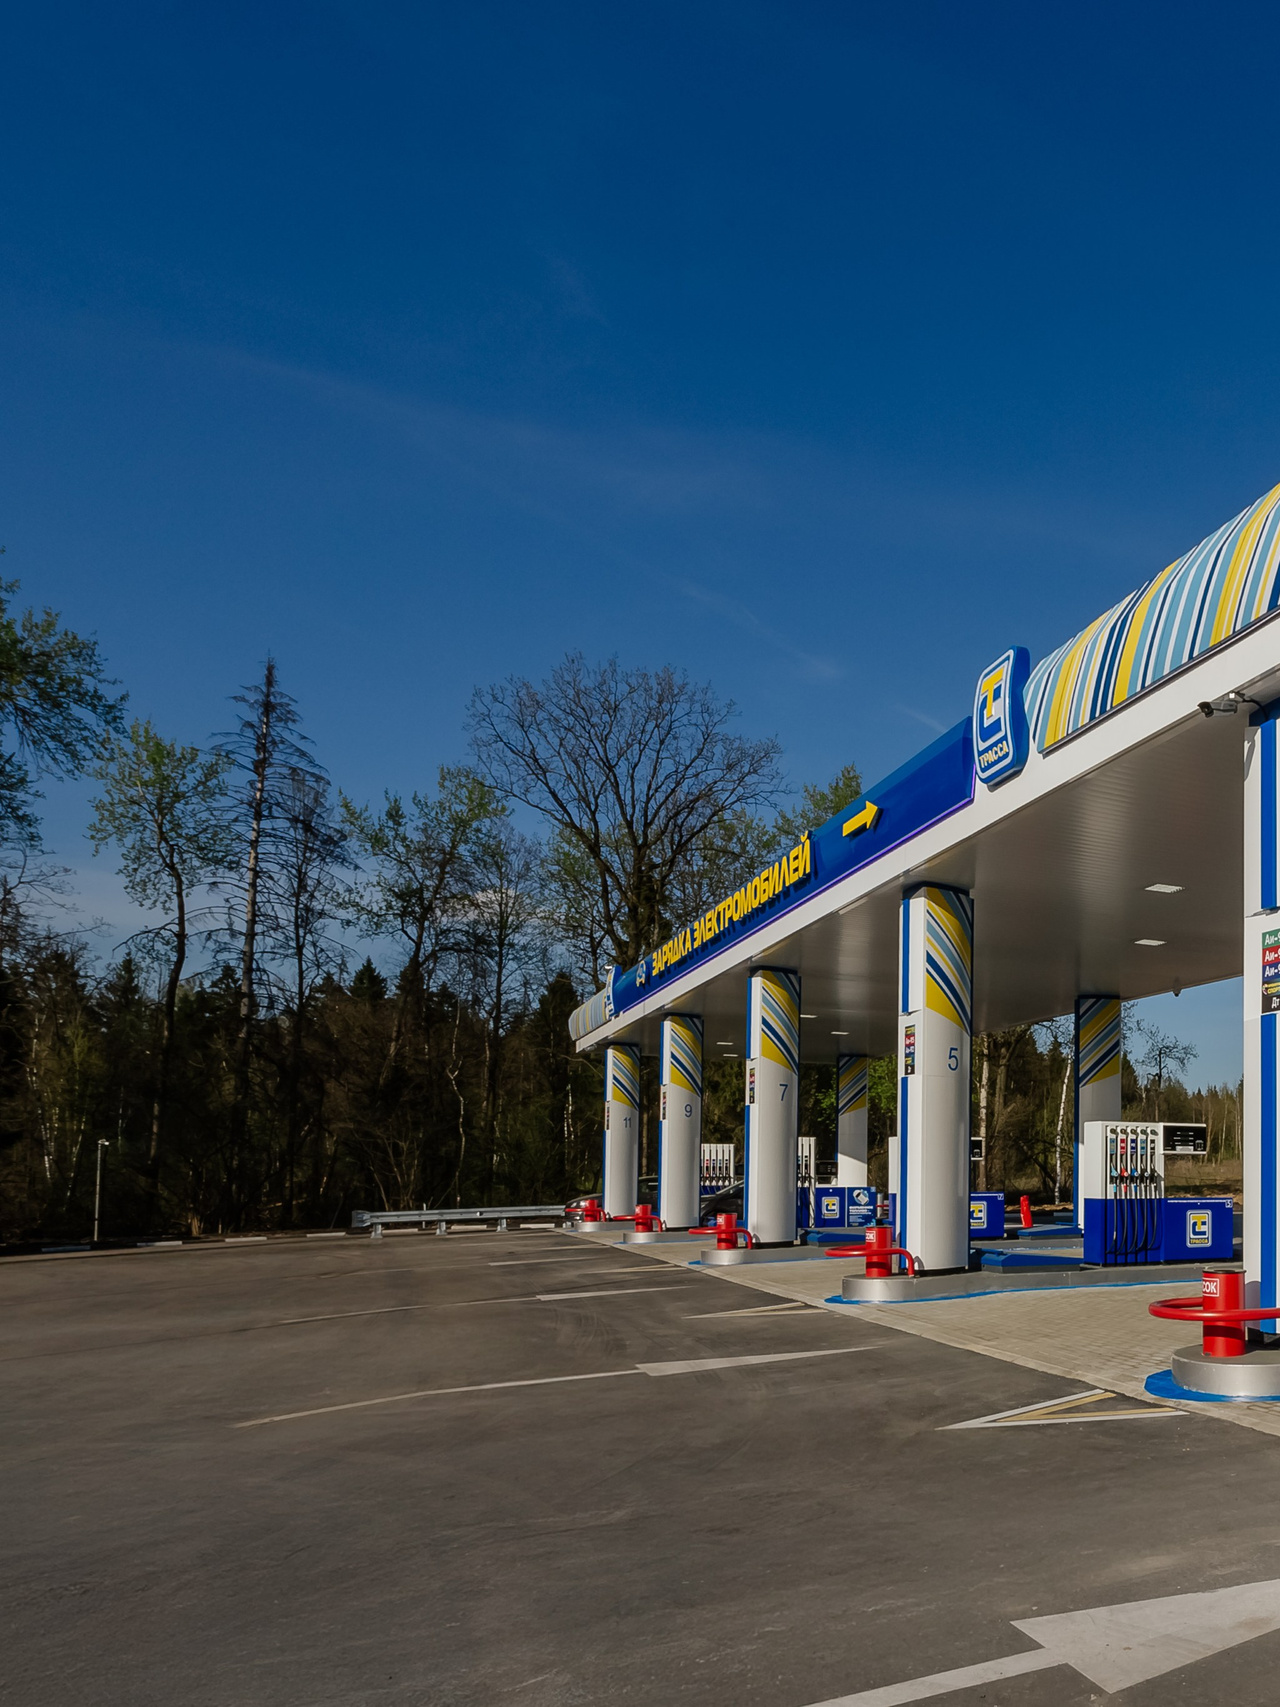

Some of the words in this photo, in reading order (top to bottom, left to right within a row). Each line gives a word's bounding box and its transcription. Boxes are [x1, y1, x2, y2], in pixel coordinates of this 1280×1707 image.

[979, 741, 1009, 768] ТРАССА
[652, 928, 692, 976] ЗАРЯДКА
[693, 831, 811, 949] ЭЛЕКТРОМОБИЛЕЙ
[948, 1047, 959, 1071] 5
[779, 1084, 789, 1101] 7
[684, 1104, 693, 1118] 9
[623, 1117, 632, 1128] 11
